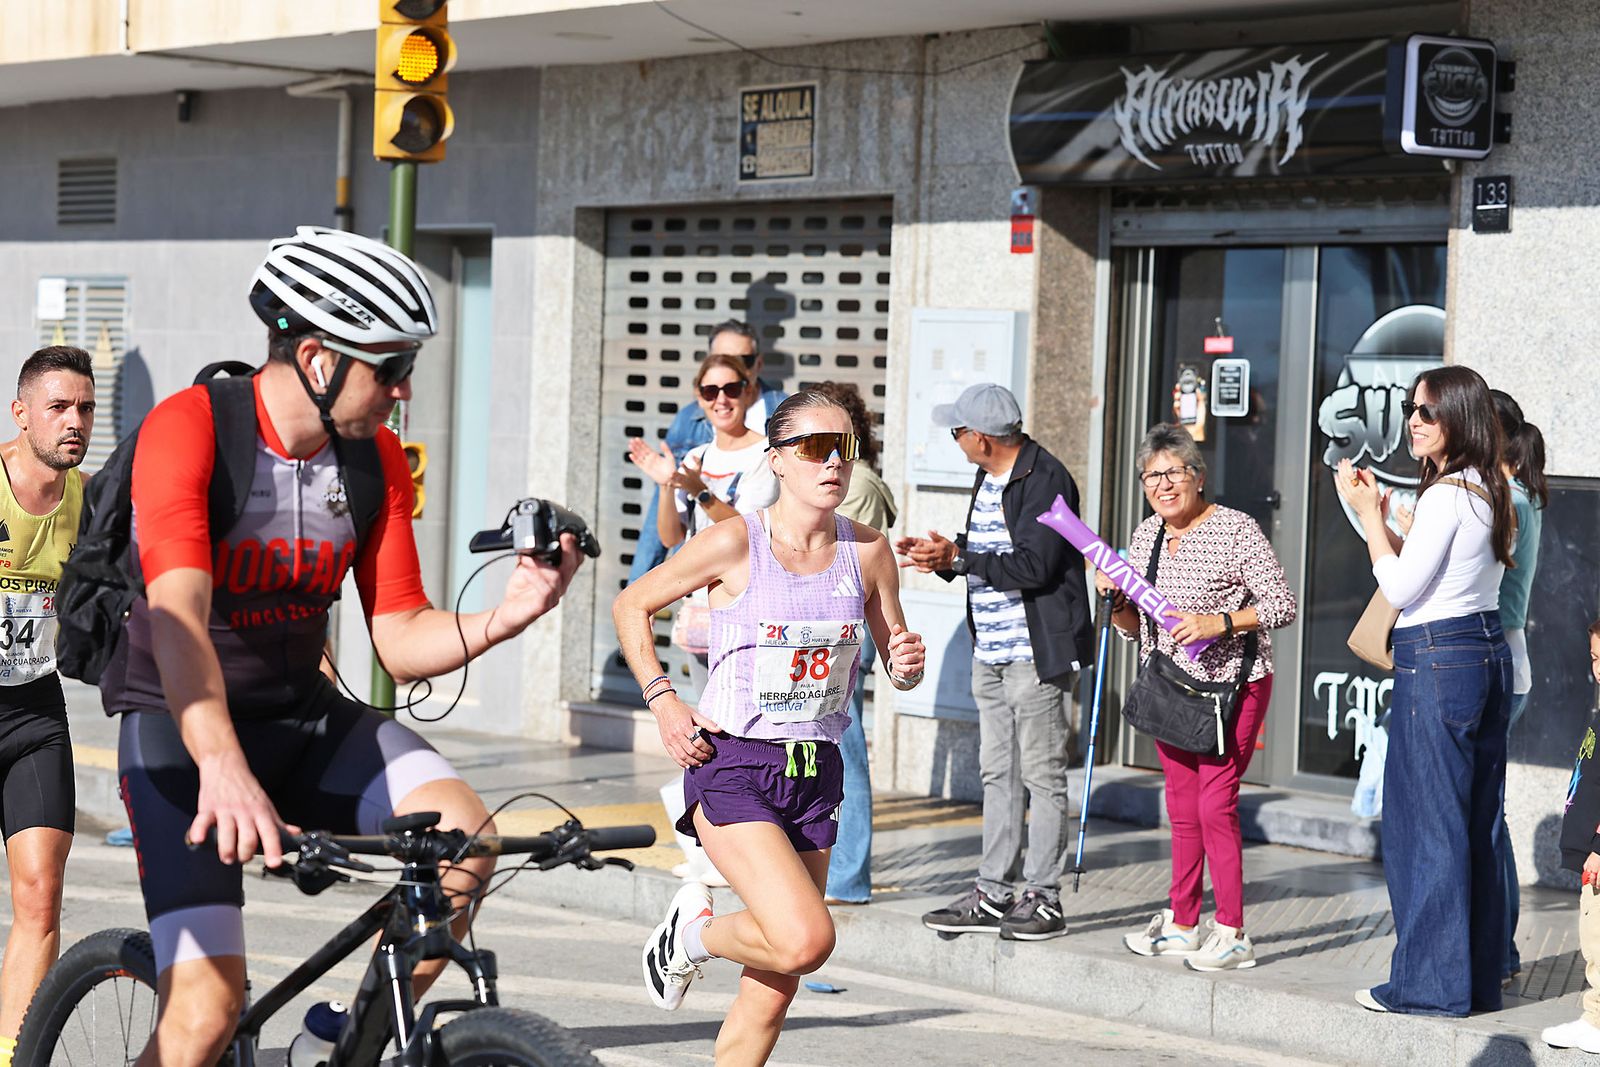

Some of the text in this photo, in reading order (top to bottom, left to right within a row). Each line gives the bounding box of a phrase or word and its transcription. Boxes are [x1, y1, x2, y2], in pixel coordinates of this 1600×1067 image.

[743, 89, 812, 122] SE ALQUILA
[1430, 127, 1476, 146] TATTOO
[1184, 143, 1245, 167] TATTOO
[1477, 182, 1508, 205] 133
[328, 291, 376, 324] LAZER
[766, 624, 790, 641] 21K
[13, 655, 50, 666] CUADRADO
[789, 647, 831, 682] 58
[759, 690, 806, 701] HERRERO
[759, 700, 803, 712] Huelva
